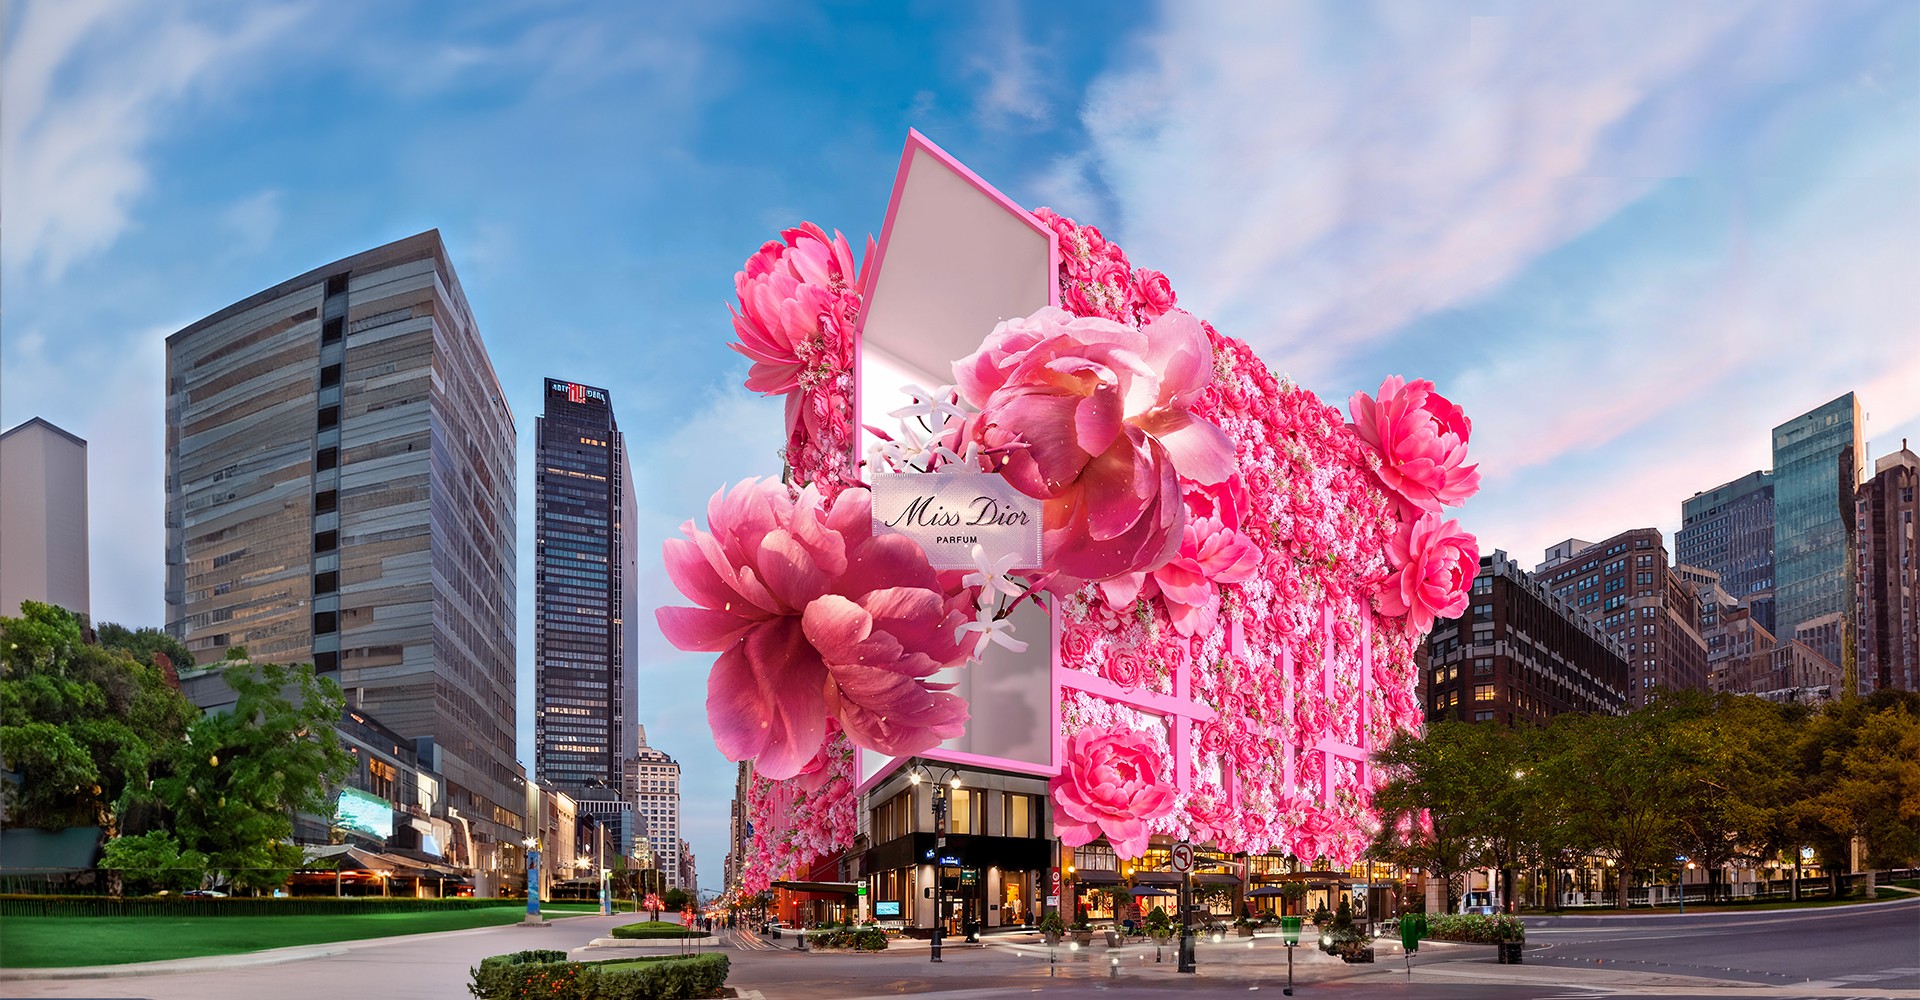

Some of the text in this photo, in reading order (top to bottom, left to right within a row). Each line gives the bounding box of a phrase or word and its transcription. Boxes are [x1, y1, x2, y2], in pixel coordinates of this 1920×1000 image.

[884, 496, 1031, 528] Miss Dior
[936, 536, 978, 544] PARFUM
